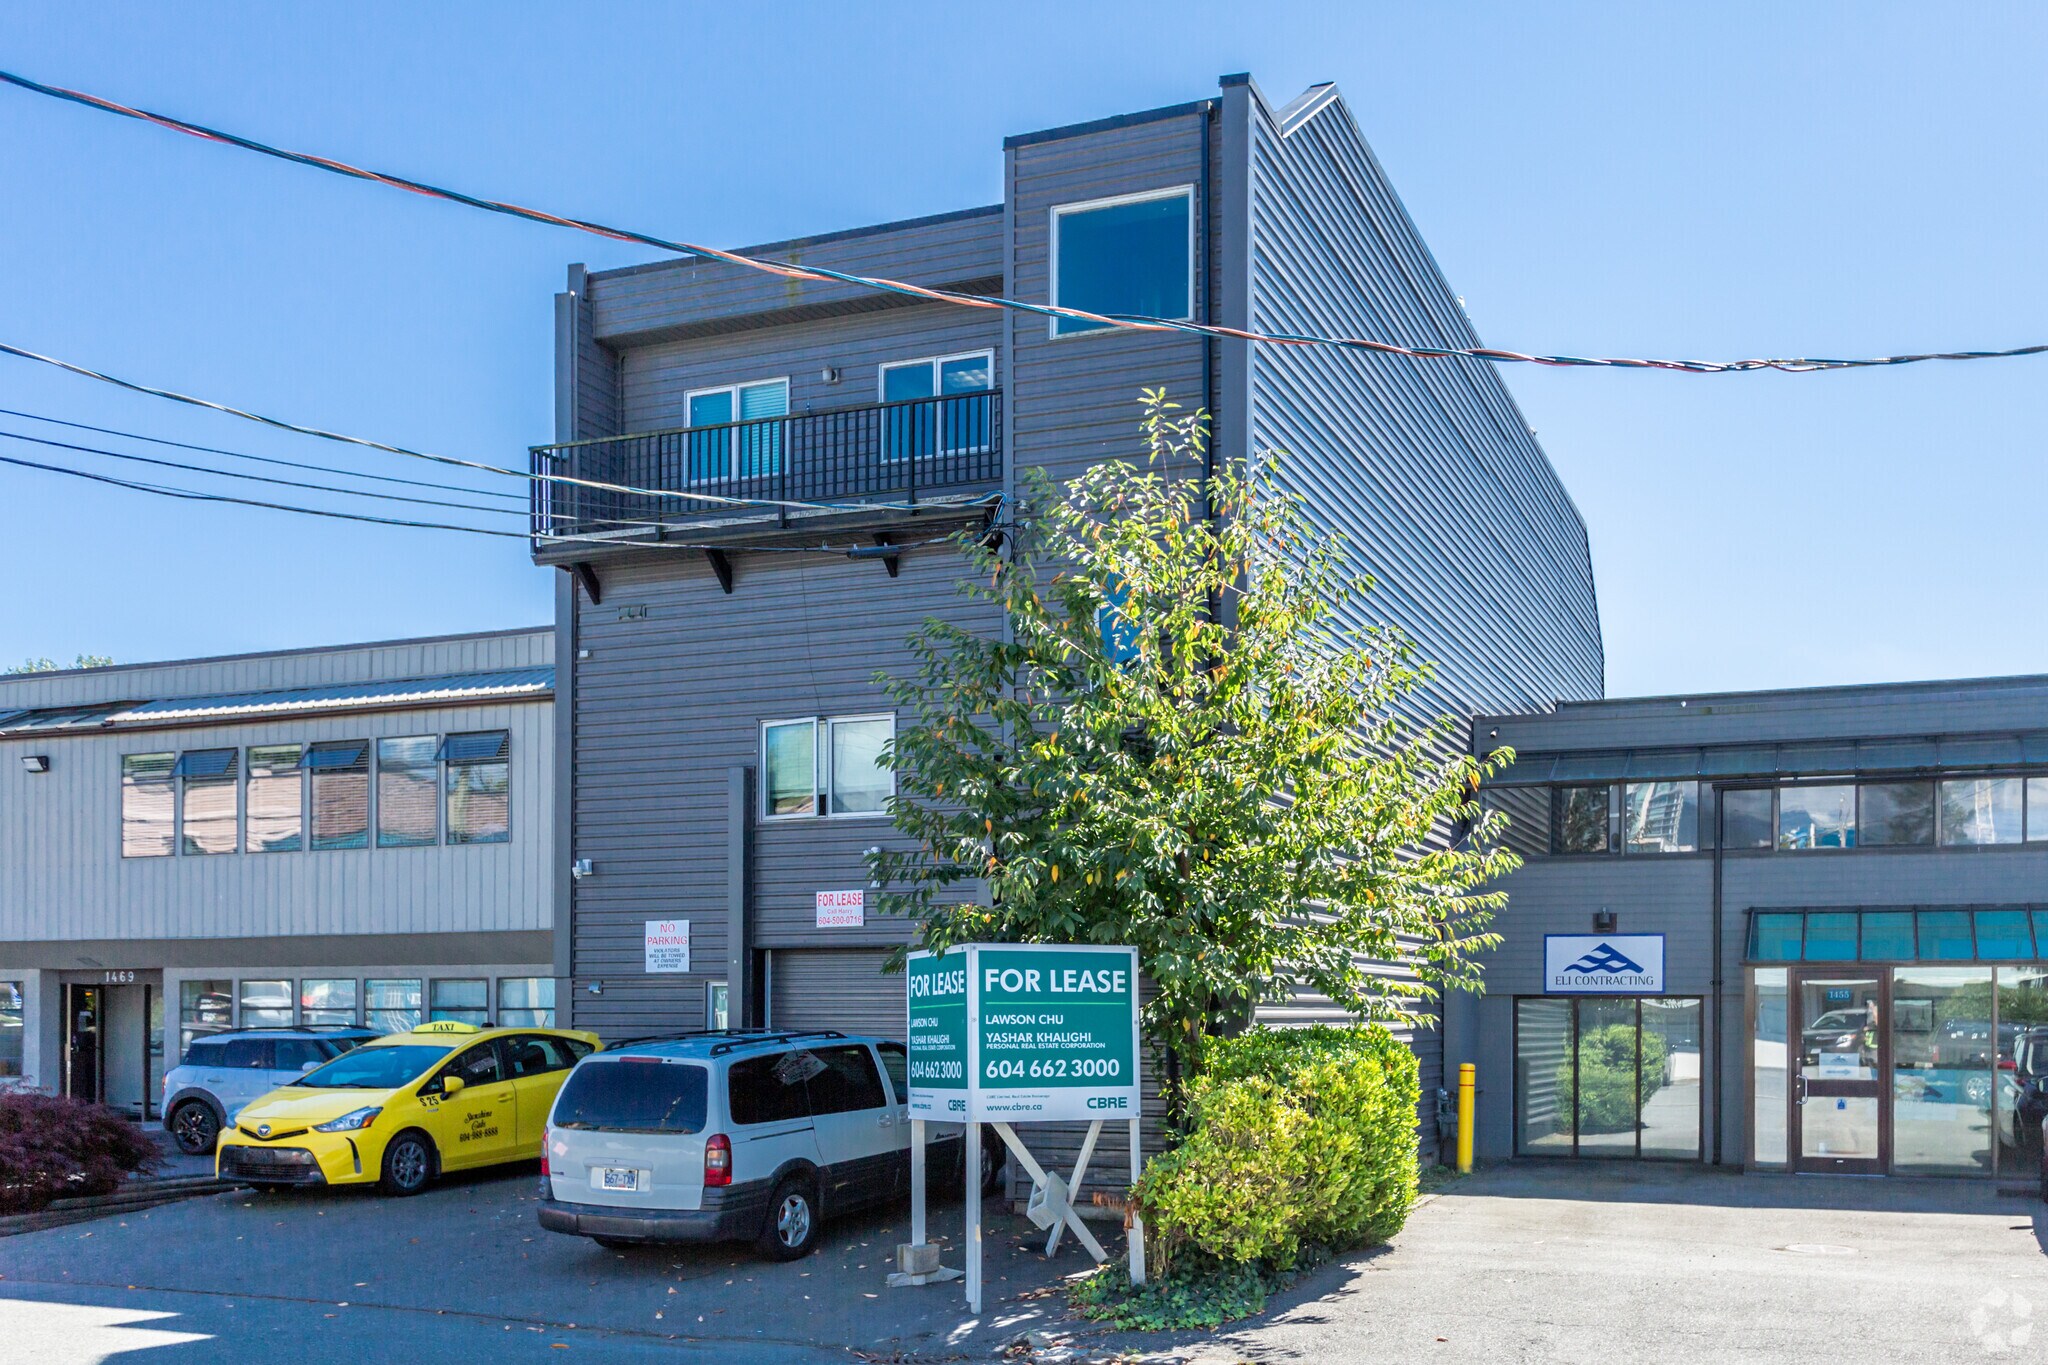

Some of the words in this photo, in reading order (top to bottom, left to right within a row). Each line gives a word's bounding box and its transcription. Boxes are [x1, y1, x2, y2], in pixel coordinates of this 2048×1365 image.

[818, 893, 834, 907] FOR
[836, 892, 862, 906] LEASE
[818, 915, 862, 925] 604-500-0716
[660, 923, 675, 933] NO
[647, 936, 687, 945] PARKING
[105, 971, 134, 982] 1469
[985, 968, 1041, 993] FOR
[1050, 969, 1126, 993] LEASE
[1555, 975, 1571, 985] ELI
[1575, 975, 1654, 985] CONTRACTING
[910, 974, 930, 998] FOR
[932, 970, 965, 995] LEASE
[1829, 990, 1850, 999] 1455
[928, 1017, 939, 1027] CHU
[985, 1014, 1035, 1025] LAWSON
[1038, 1014, 1064, 1025] CHU
[432, 1023, 455, 1031] TAXI
[986, 1032, 1033, 1042] YASHAR
[1037, 1032, 1092, 1042] KHALIGHI
[911, 1061, 924, 1078] 604
[925, 1061, 940, 1078] 662
[940, 1061, 962, 1079] 3000
[986, 1060, 1025, 1078] 604
[1029, 1059, 1067, 1078] 662
[1070, 1058, 1120, 1077] 3000
[420, 1098, 427, 1107] S
[428, 1096, 439, 1106] 25
[948, 1099, 966, 1111] CBRE
[986, 1102, 1042, 1111] www.cbre.ca
[1087, 1096, 1128, 1109] CBRE
[464, 1109, 493, 1124] Sunshine
